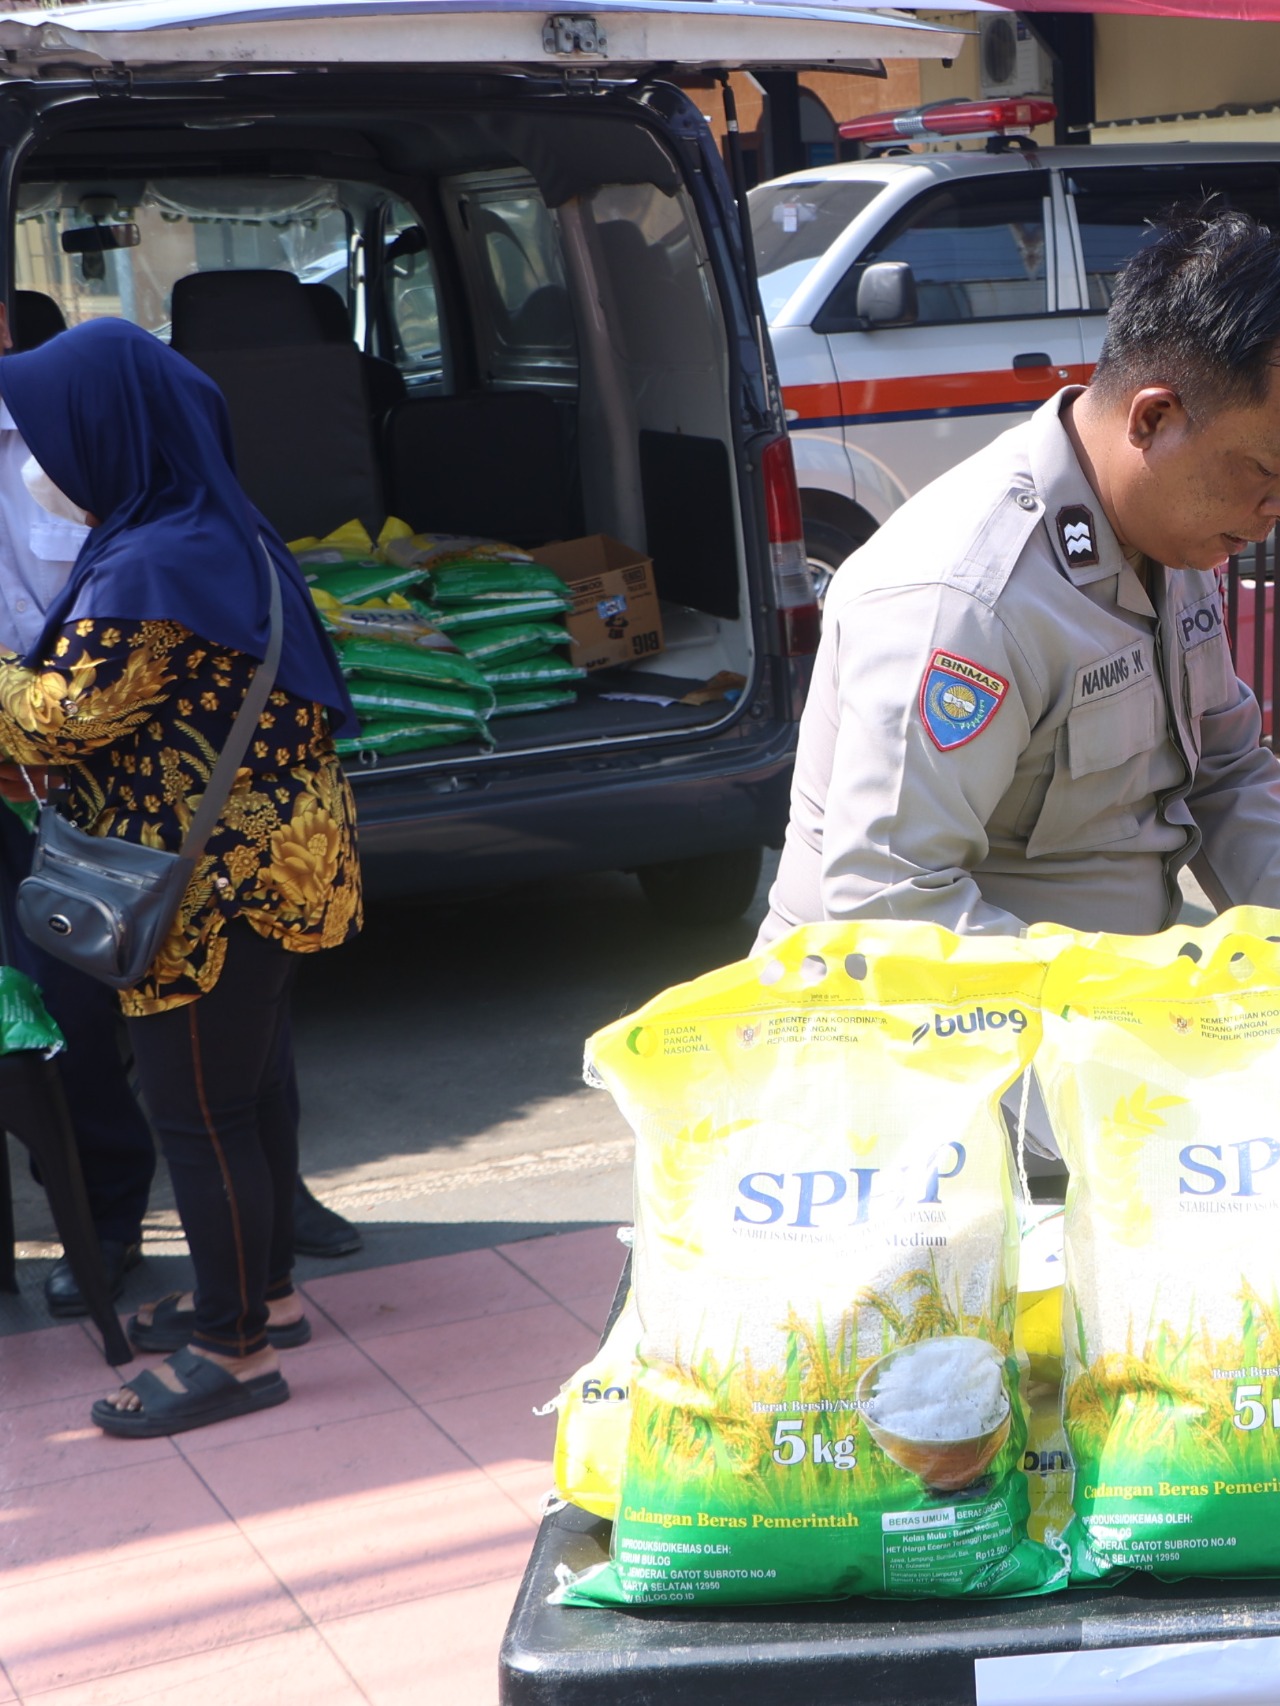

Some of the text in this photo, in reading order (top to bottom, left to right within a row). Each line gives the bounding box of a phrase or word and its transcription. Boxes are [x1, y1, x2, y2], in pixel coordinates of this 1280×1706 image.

[940, 656, 1001, 691] BINMAS
[1081, 656, 1130, 697] NANANG
[935, 1006, 1028, 1038] bulog
[1094, 1016, 1143, 1024] NASIONAL
[664, 1026, 696, 1036] BADAN
[768, 1025, 837, 1035] BIDANG PNGAN
[1201, 1020, 1268, 1032] BIDANG PANGAN
[664, 1035, 702, 1045] PANGAN
[810, 1035, 858, 1043] INDONESIA
[1201, 1031, 1242, 1041] REPUBLIK
[663, 1044, 710, 1055] NASIONAL
[1178, 1201, 1243, 1214] STABILISASI
[1212, 1367, 1246, 1379] Berat
[752, 1400, 787, 1412] Berat
[1233, 1384, 1266, 1431] 5
[773, 1419, 857, 1470] 5 kg
[1084, 1482, 1153, 1500] Cadangan
[1158, 1481, 1209, 1496] Beras
[624, 1506, 859, 1529] Cadangan Beras Pemerintah
[889, 1513, 950, 1526] BERAS UMUM
[1166, 1513, 1193, 1524] OLEH:
[902, 1533, 926, 1543] Kelas
[926, 1532, 947, 1541] Mutu
[704, 1544, 731, 1554] OLEH:
[886, 1545, 901, 1553] HET
[1131, 1537, 1237, 1550] GATOT SUBROTO NO.49
[641, 1555, 671, 1566] BULOG
[1112, 1553, 1152, 1563] SELATAN
[1156, 1552, 1180, 1562] 12950
[670, 1570, 702, 1579] GATOT
[703, 1569, 748, 1579] SUBROTO
[750, 1569, 777, 1578] NO.49
[651, 1581, 720, 1591] SELATAN 12950
